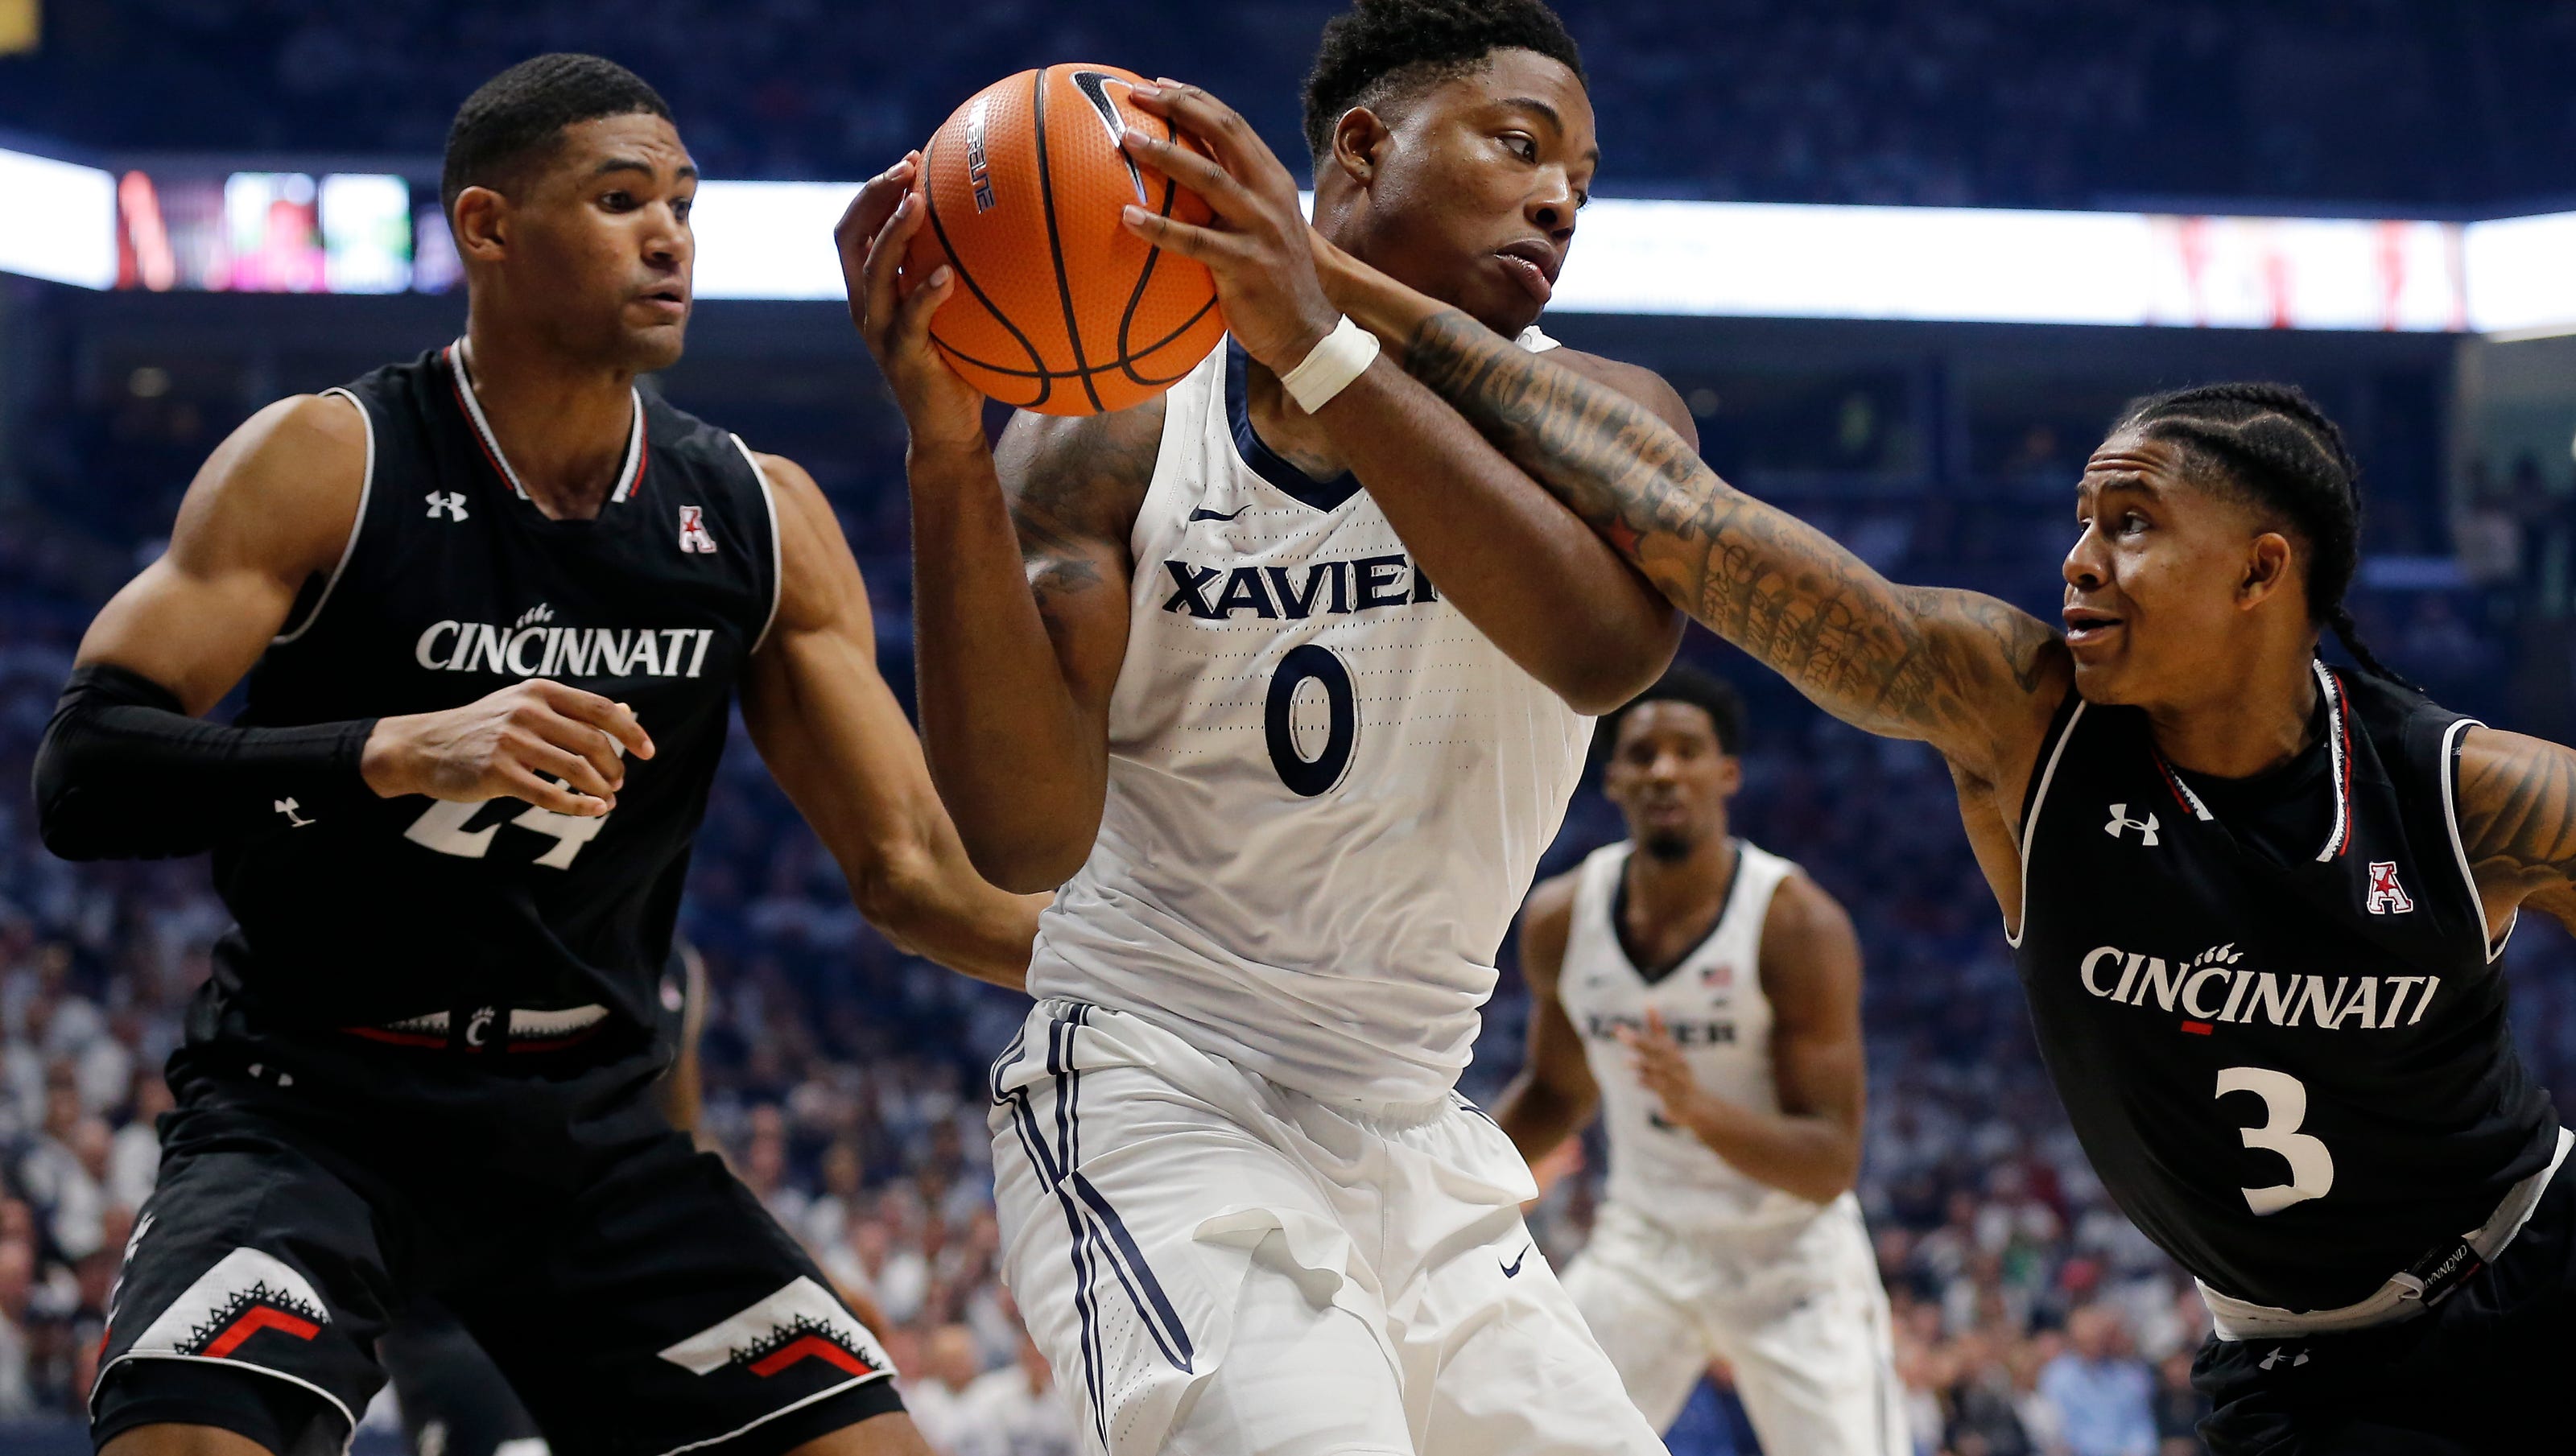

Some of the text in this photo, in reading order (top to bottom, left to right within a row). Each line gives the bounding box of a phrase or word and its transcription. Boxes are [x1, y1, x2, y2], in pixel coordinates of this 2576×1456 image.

[416, 618, 713, 679] CINCINNATI
[1264, 644, 1360, 797] 0
[2080, 945, 2440, 1029] CINCINNATI
[2215, 1066, 2334, 1216] 3
[2425, 1244, 2467, 1289] CINCINNAT
